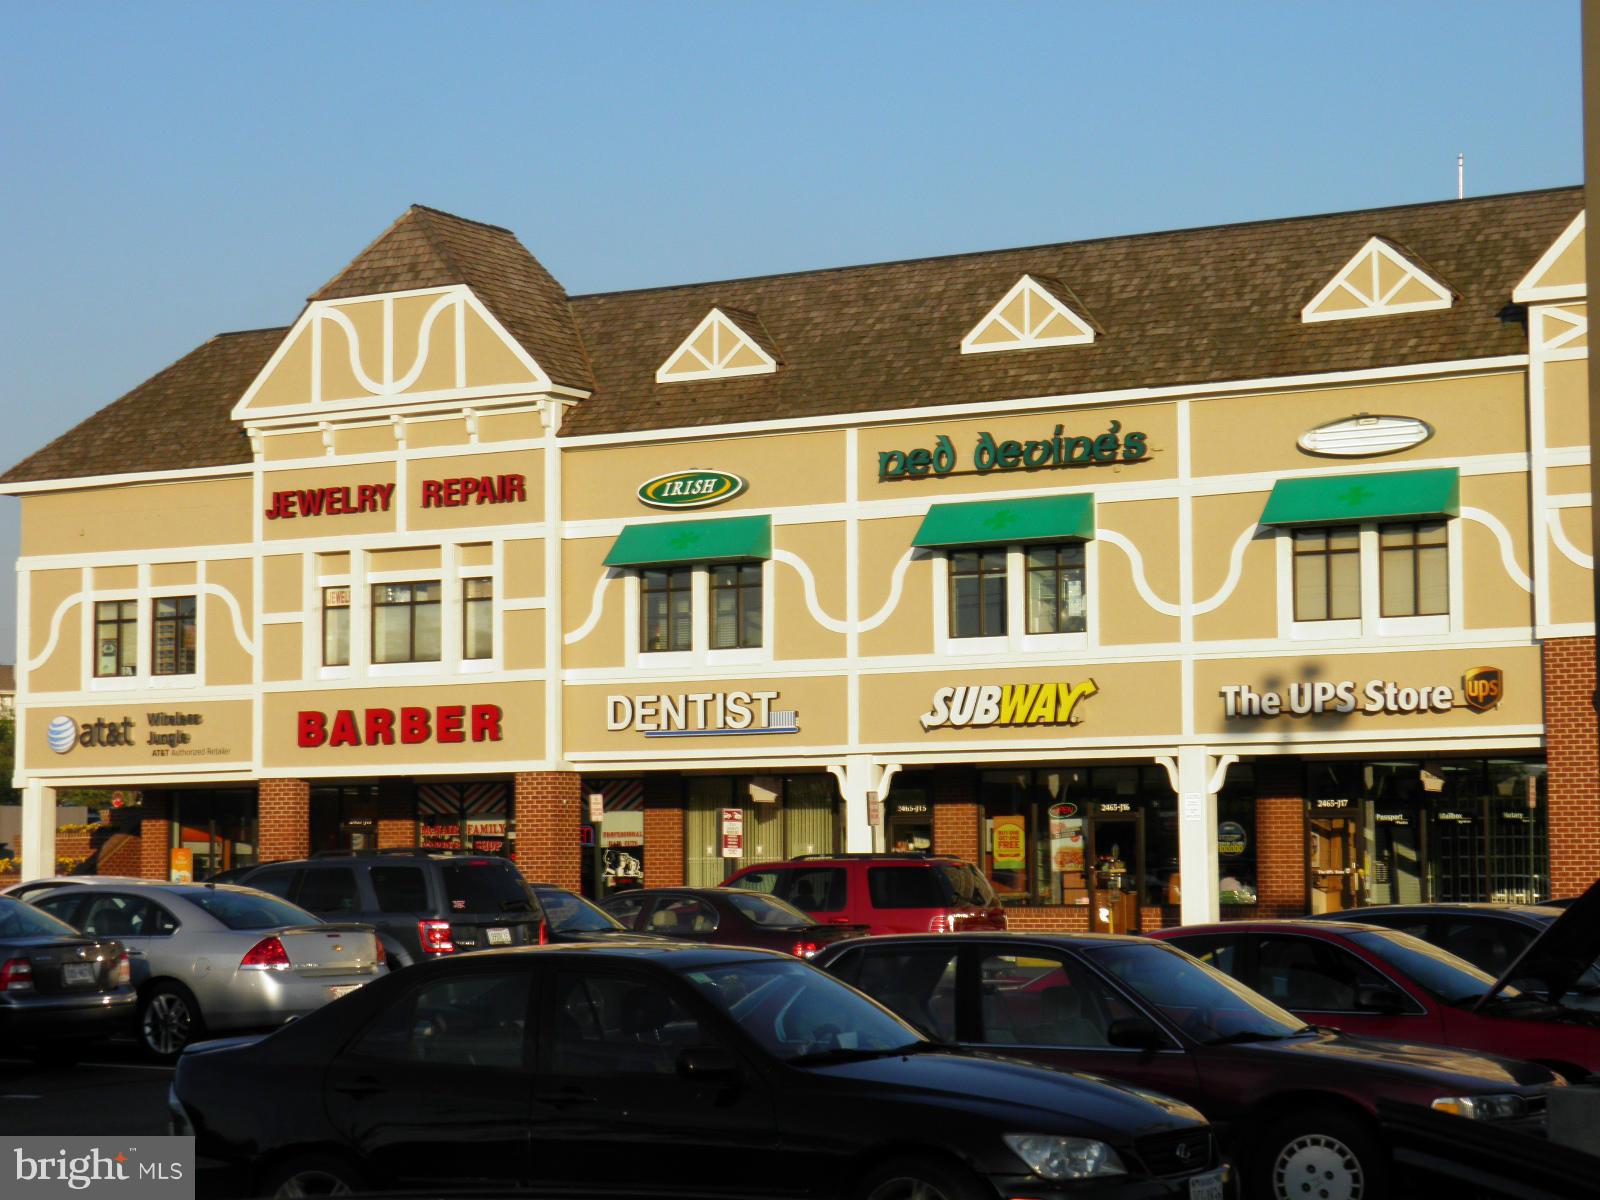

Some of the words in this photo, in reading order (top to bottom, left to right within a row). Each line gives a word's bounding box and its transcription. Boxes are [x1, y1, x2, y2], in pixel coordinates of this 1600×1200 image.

[879, 434, 957, 480] ned
[974, 419, 1149, 470] devine's
[265, 483, 396, 519] JEWELRY
[421, 473, 526, 509] REPAIR
[661, 478, 718, 497] IRISH
[920, 678, 1099, 728] SUBWAY
[1220, 685, 1281, 716] The
[1288, 680, 1356, 714] UPS
[1364, 680, 1454, 712] Store
[1467, 677, 1499, 704] ups
[146, 712, 203, 727] Wireless
[297, 704, 503, 748] BARBER
[607, 691, 780, 732] DENTIST
[80, 716, 135, 748] at&t
[147, 730, 191, 748] Jungle
[171, 748, 205, 757] Authorized
[466, 823, 505, 834] FAMILY
[999, 841, 1020, 849] FREE
